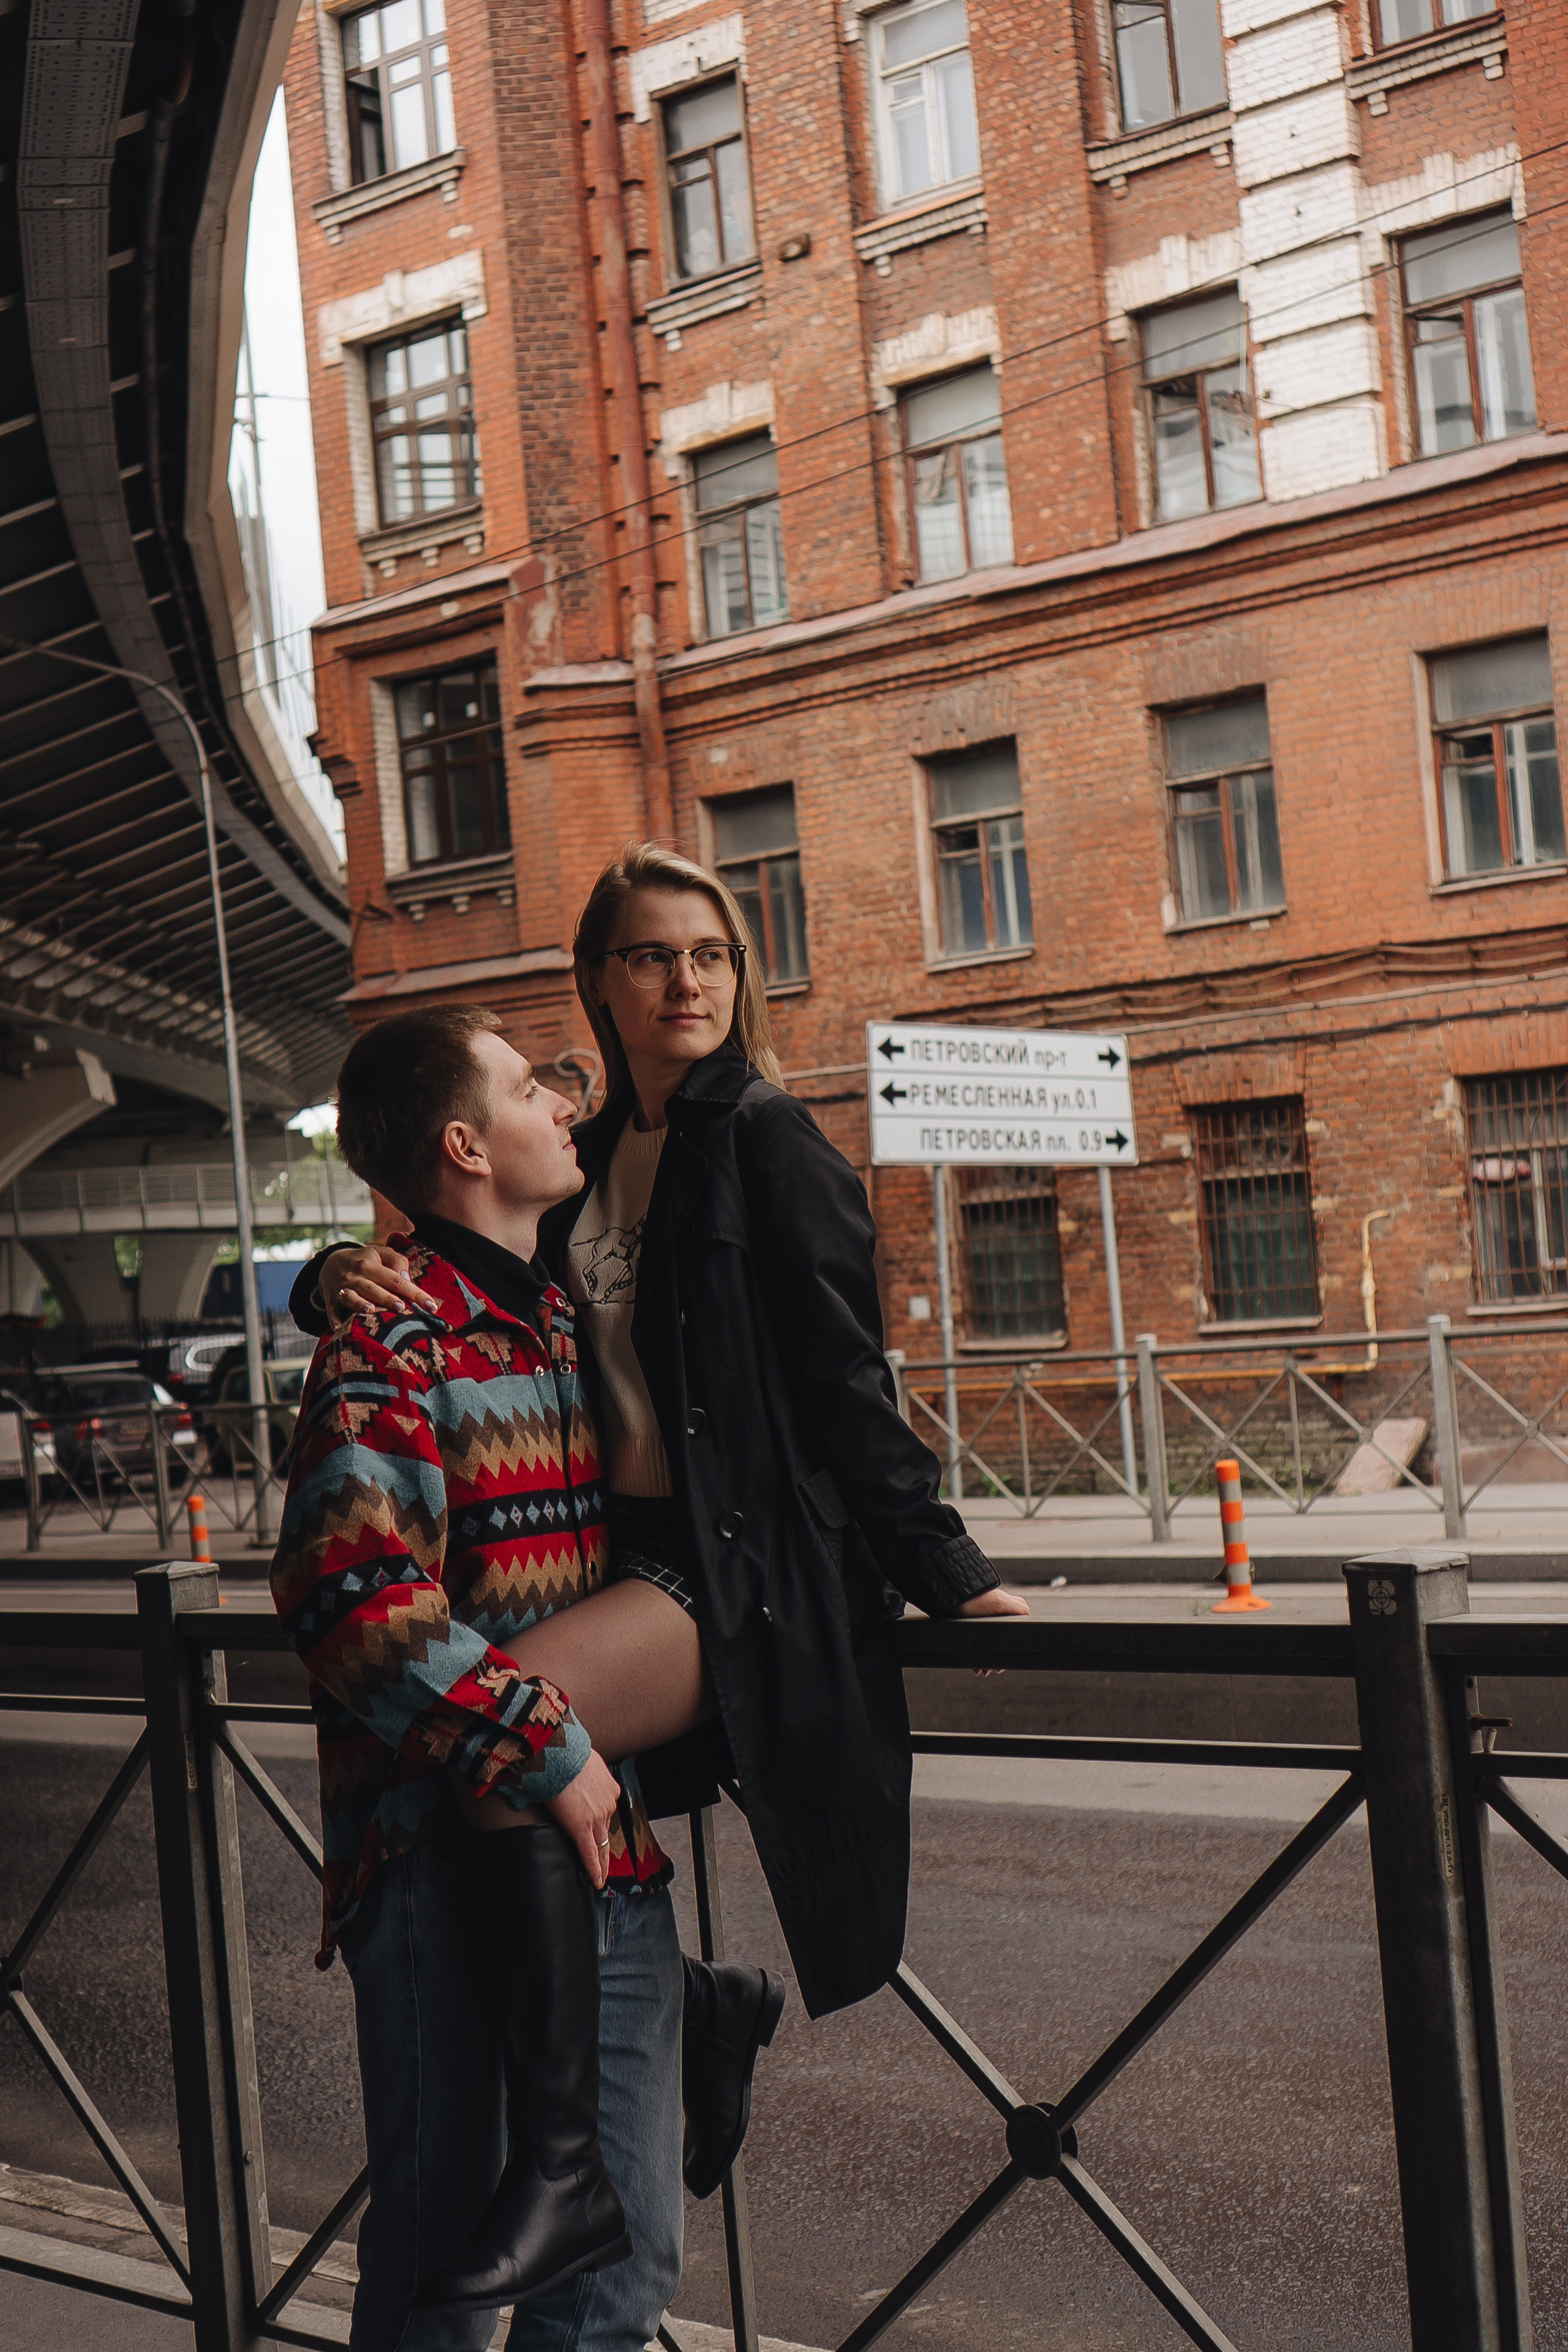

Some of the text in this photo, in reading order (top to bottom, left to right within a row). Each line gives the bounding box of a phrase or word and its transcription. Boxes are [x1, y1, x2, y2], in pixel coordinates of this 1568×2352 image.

[911, 1039, 1066, 1071] ПЕТРОВСКИЙ пр-т
[910, 1085, 1047, 1108] РЕМЕСЛЕННАЯ
[921, 1128, 1102, 1152] ПЕТРОВСКАЯ пл. 0.9
